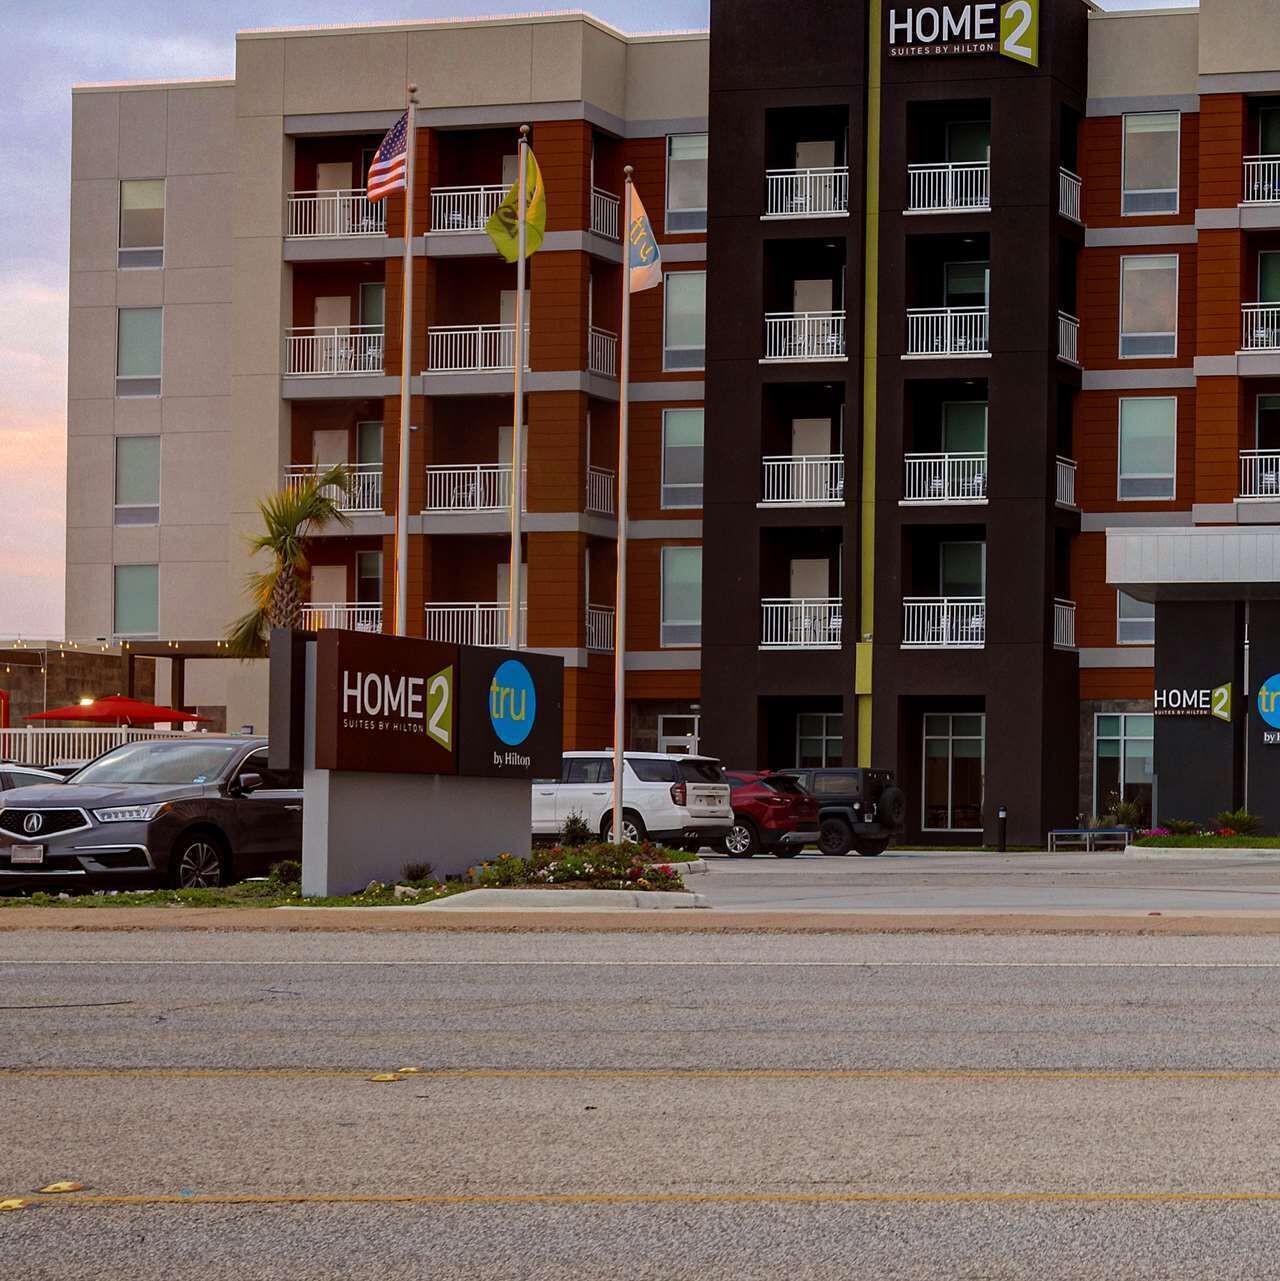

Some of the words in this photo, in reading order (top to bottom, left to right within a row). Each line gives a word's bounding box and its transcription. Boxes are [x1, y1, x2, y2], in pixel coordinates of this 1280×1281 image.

[891, 47, 930, 56] SUITES
[935, 46, 948, 54] BY
[953, 43, 994, 53] HILTON
[489, 677, 527, 721] tru
[343, 719, 376, 731] SUITES
[378, 721, 390, 732] BY
[392, 723, 424, 735] HILTON
[1263, 732, 1275, 744] by
[493, 751, 503, 768] by
[504, 752, 531, 766] Hilton
